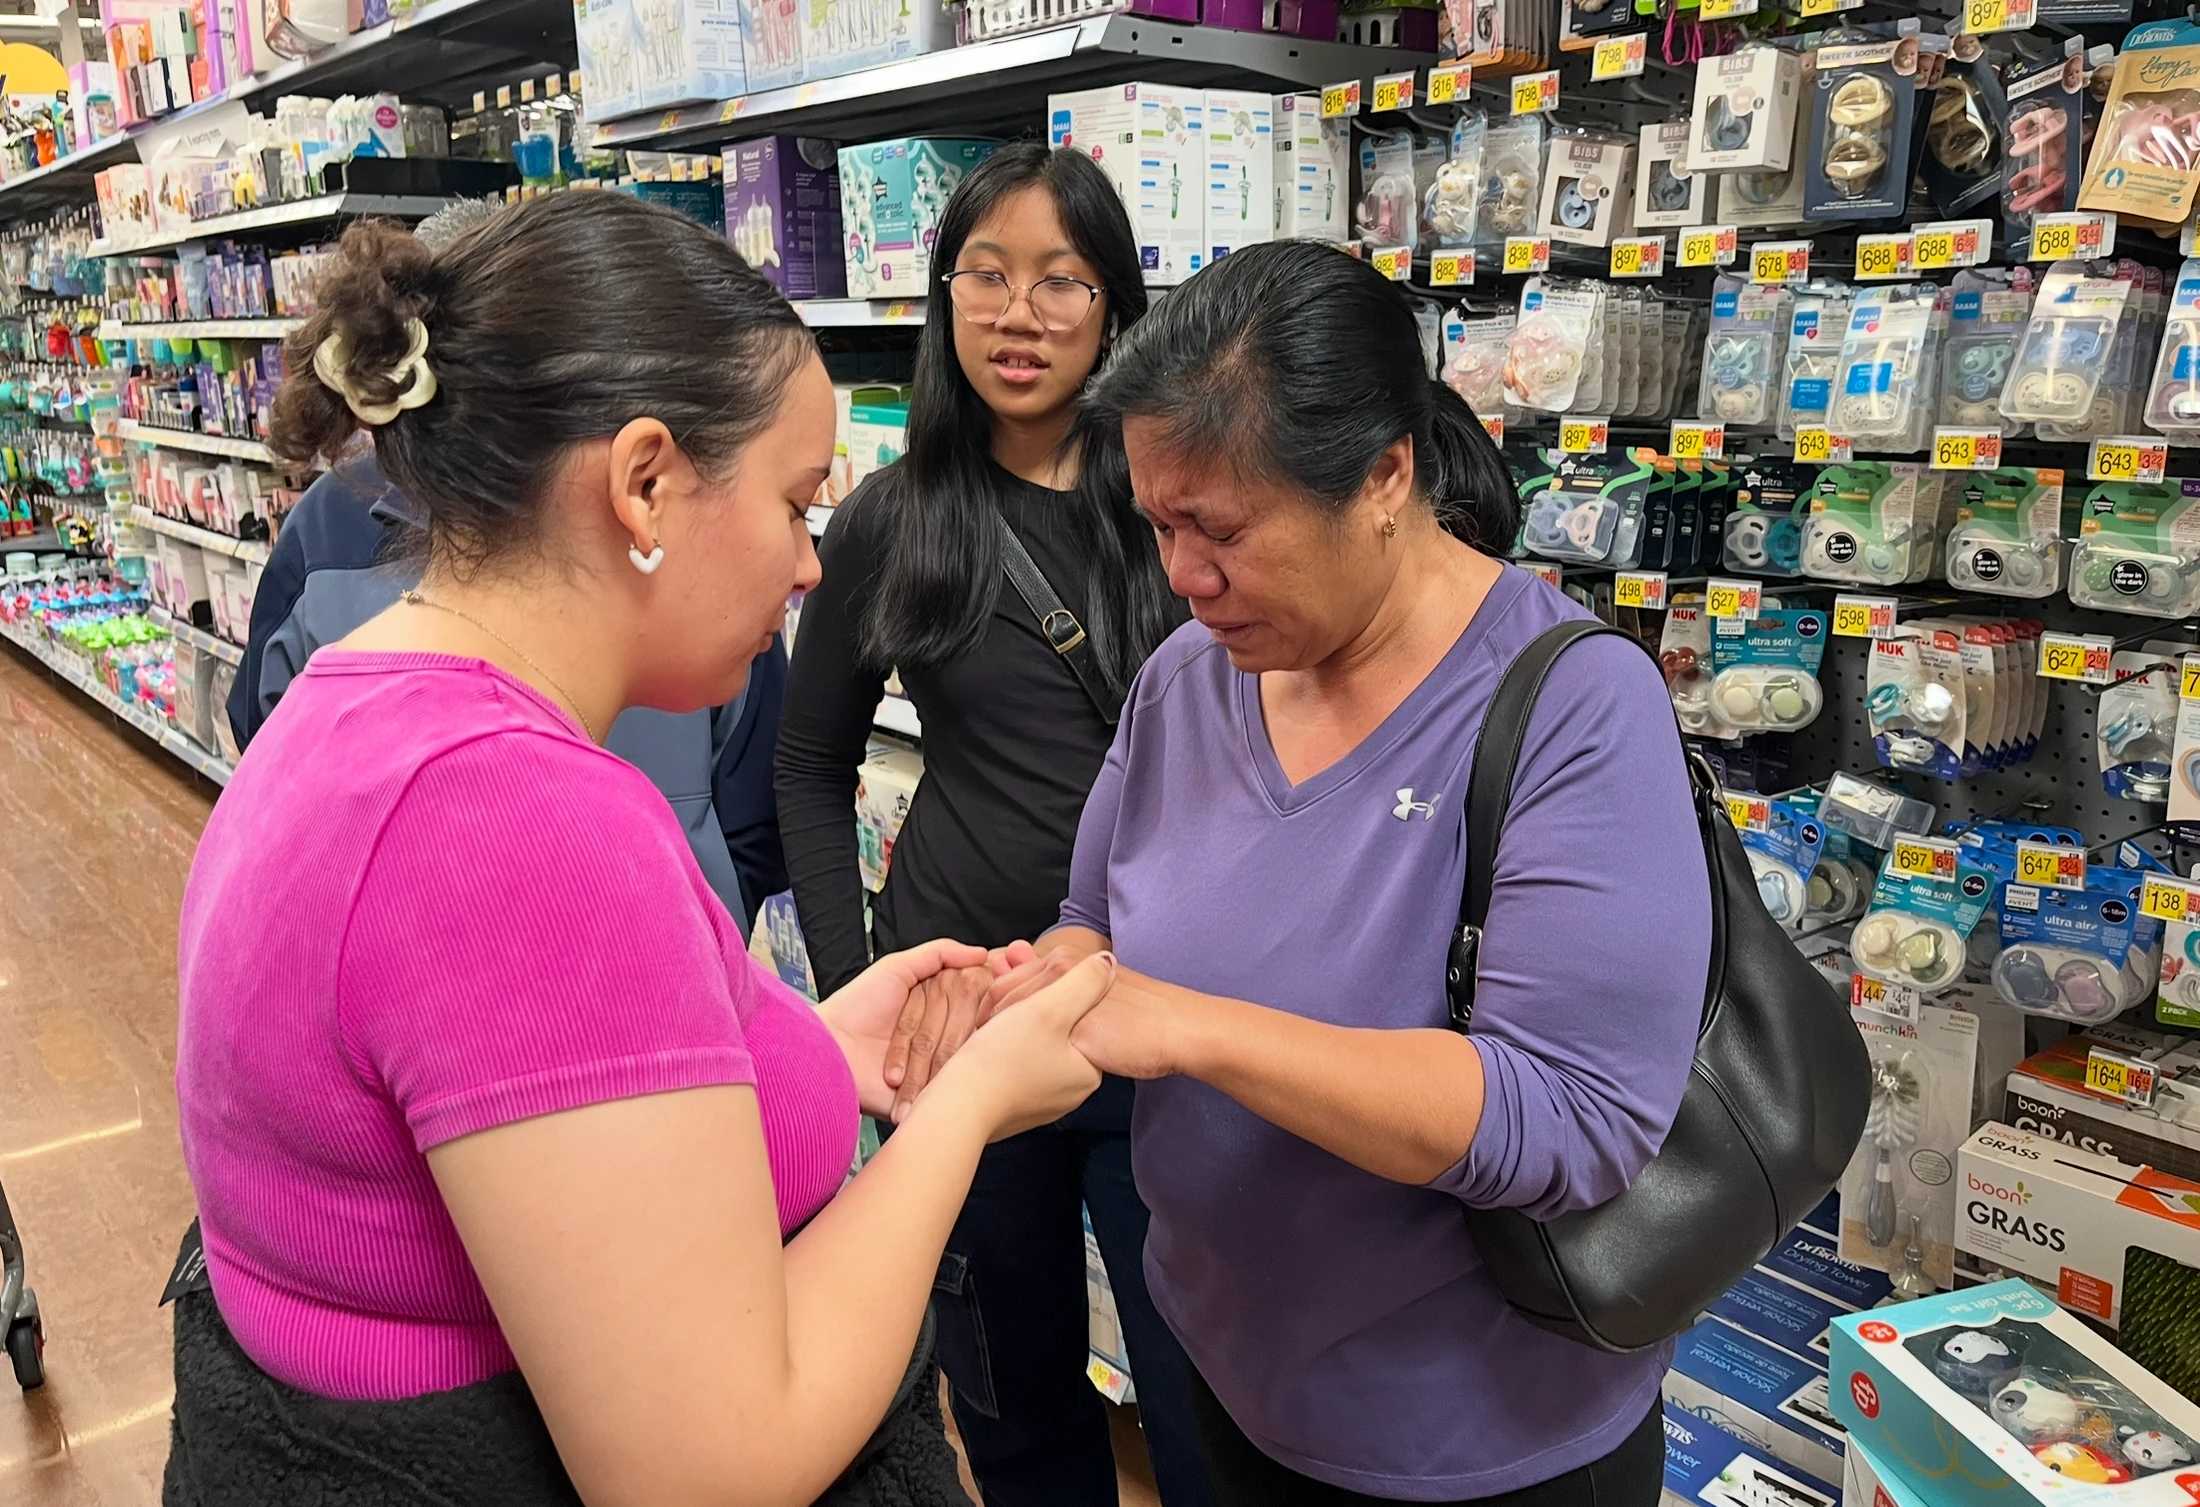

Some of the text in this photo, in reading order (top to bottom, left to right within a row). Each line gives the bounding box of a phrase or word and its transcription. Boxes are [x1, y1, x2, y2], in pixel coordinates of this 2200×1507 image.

[1971, 1, 2001, 27] 897
[1600, 47, 1622, 70] 798
[1722, 58, 1749, 71] BIBS
[1377, 87, 1396, 107] 816
[1432, 78, 1451, 98] 816
[1517, 85, 1537, 109] 798
[1324, 93, 1343, 112] 816
[1662, 126, 1686, 138] BIBS
[1574, 146, 1598, 157] BIBS
[1687, 239, 1711, 261] 678
[1918, 239, 1947, 263] 688
[2039, 230, 2070, 254] 688
[1508, 246, 1528, 265] 838
[1615, 249, 1637, 270] 897
[1862, 247, 1890, 271] 688
[1436, 262, 1454, 280] 882
[1758, 256, 1782, 278] 678
[1954, 302, 1979, 310] MAM
[1564, 429, 1586, 448] 897
[1676, 434, 1700, 454] 897
[1800, 434, 1825, 456] 643
[1940, 441, 1969, 463] 643
[1762, 478, 1783, 487] ultra
[1619, 582, 1640, 600] 498
[1711, 591, 1735, 610] 627
[1672, 609, 1697, 621] NUK
[1838, 609, 1864, 629] 598
[1748, 637, 1792, 646] ultra soft
[1876, 642, 1904, 657] NUK
[2047, 649, 2079, 671] 627
[2024, 855, 2052, 876] 647
[1910, 884, 1953, 902] ultra soft
[2044, 915, 2072, 928] ultra
[1863, 986, 1887, 1004] 447
[1856, 1020, 1919, 1039] munchkin
[2018, 1096, 2060, 1120] boon
[1978, 1136, 2042, 1160] GRASS
[1968, 1172, 2022, 1206] boon
[1967, 1200, 2066, 1252] GRASS
